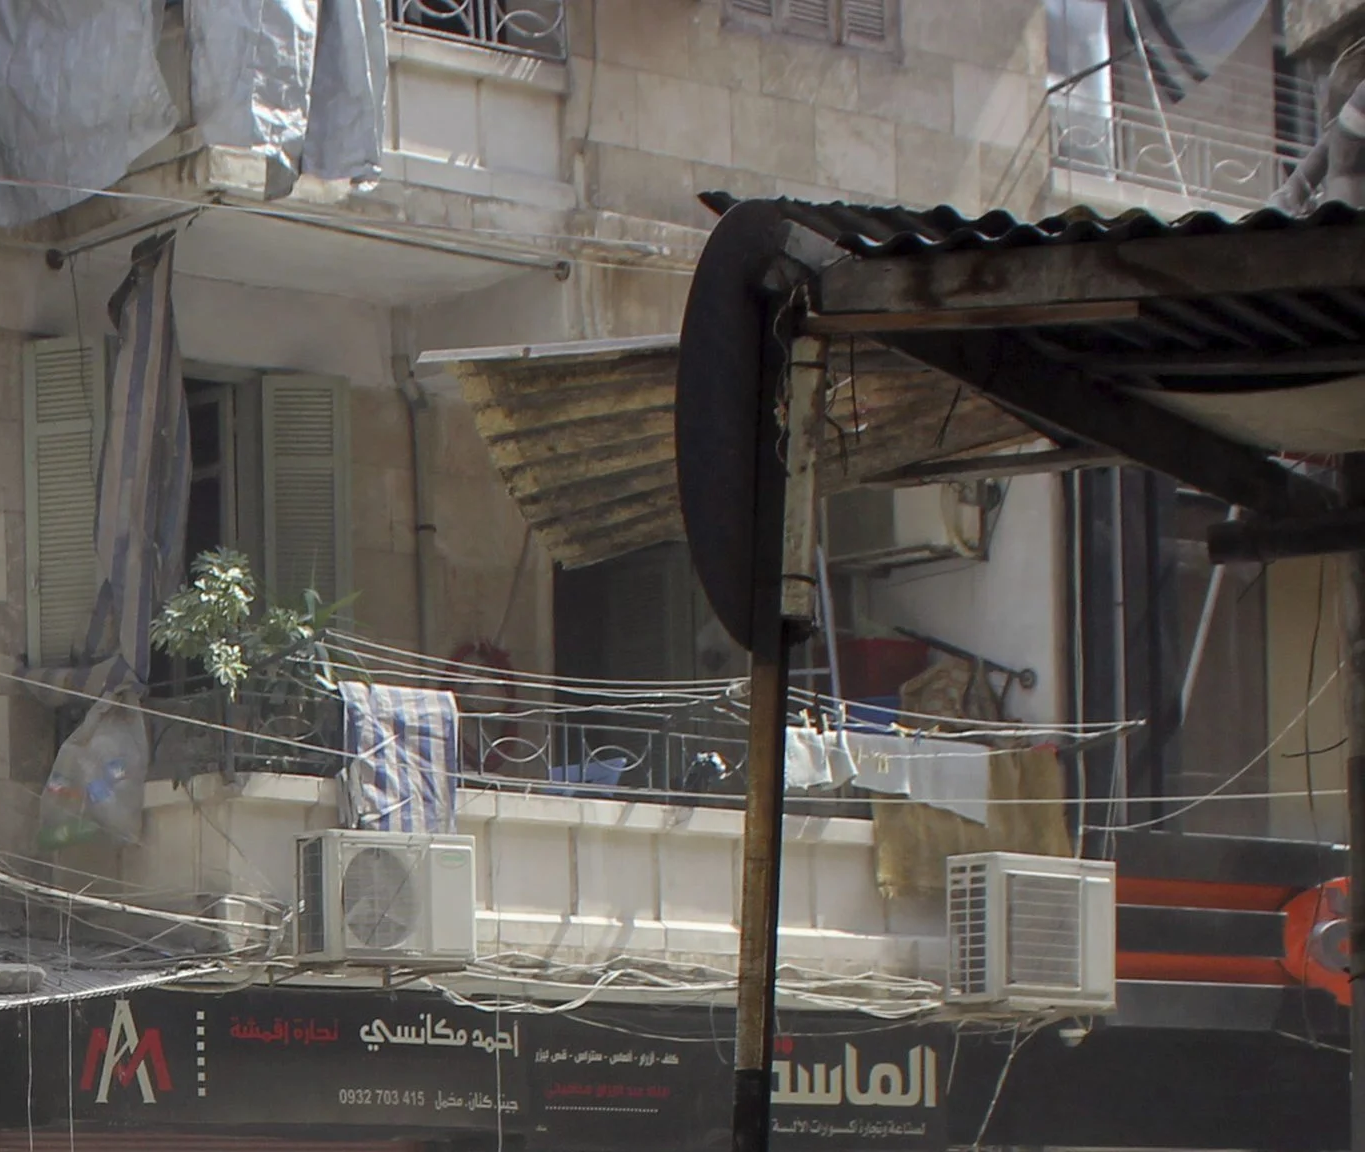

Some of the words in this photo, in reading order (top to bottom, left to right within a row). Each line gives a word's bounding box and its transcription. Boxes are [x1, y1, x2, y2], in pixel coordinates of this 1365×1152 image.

[360, 1013, 467, 1051] مكانسي
[472, 1021, 519, 1057] أحمد
[339, 1089, 372, 1105] 0932
[376, 1090, 400, 1105] 703
[403, 1091, 425, 1106] 415
